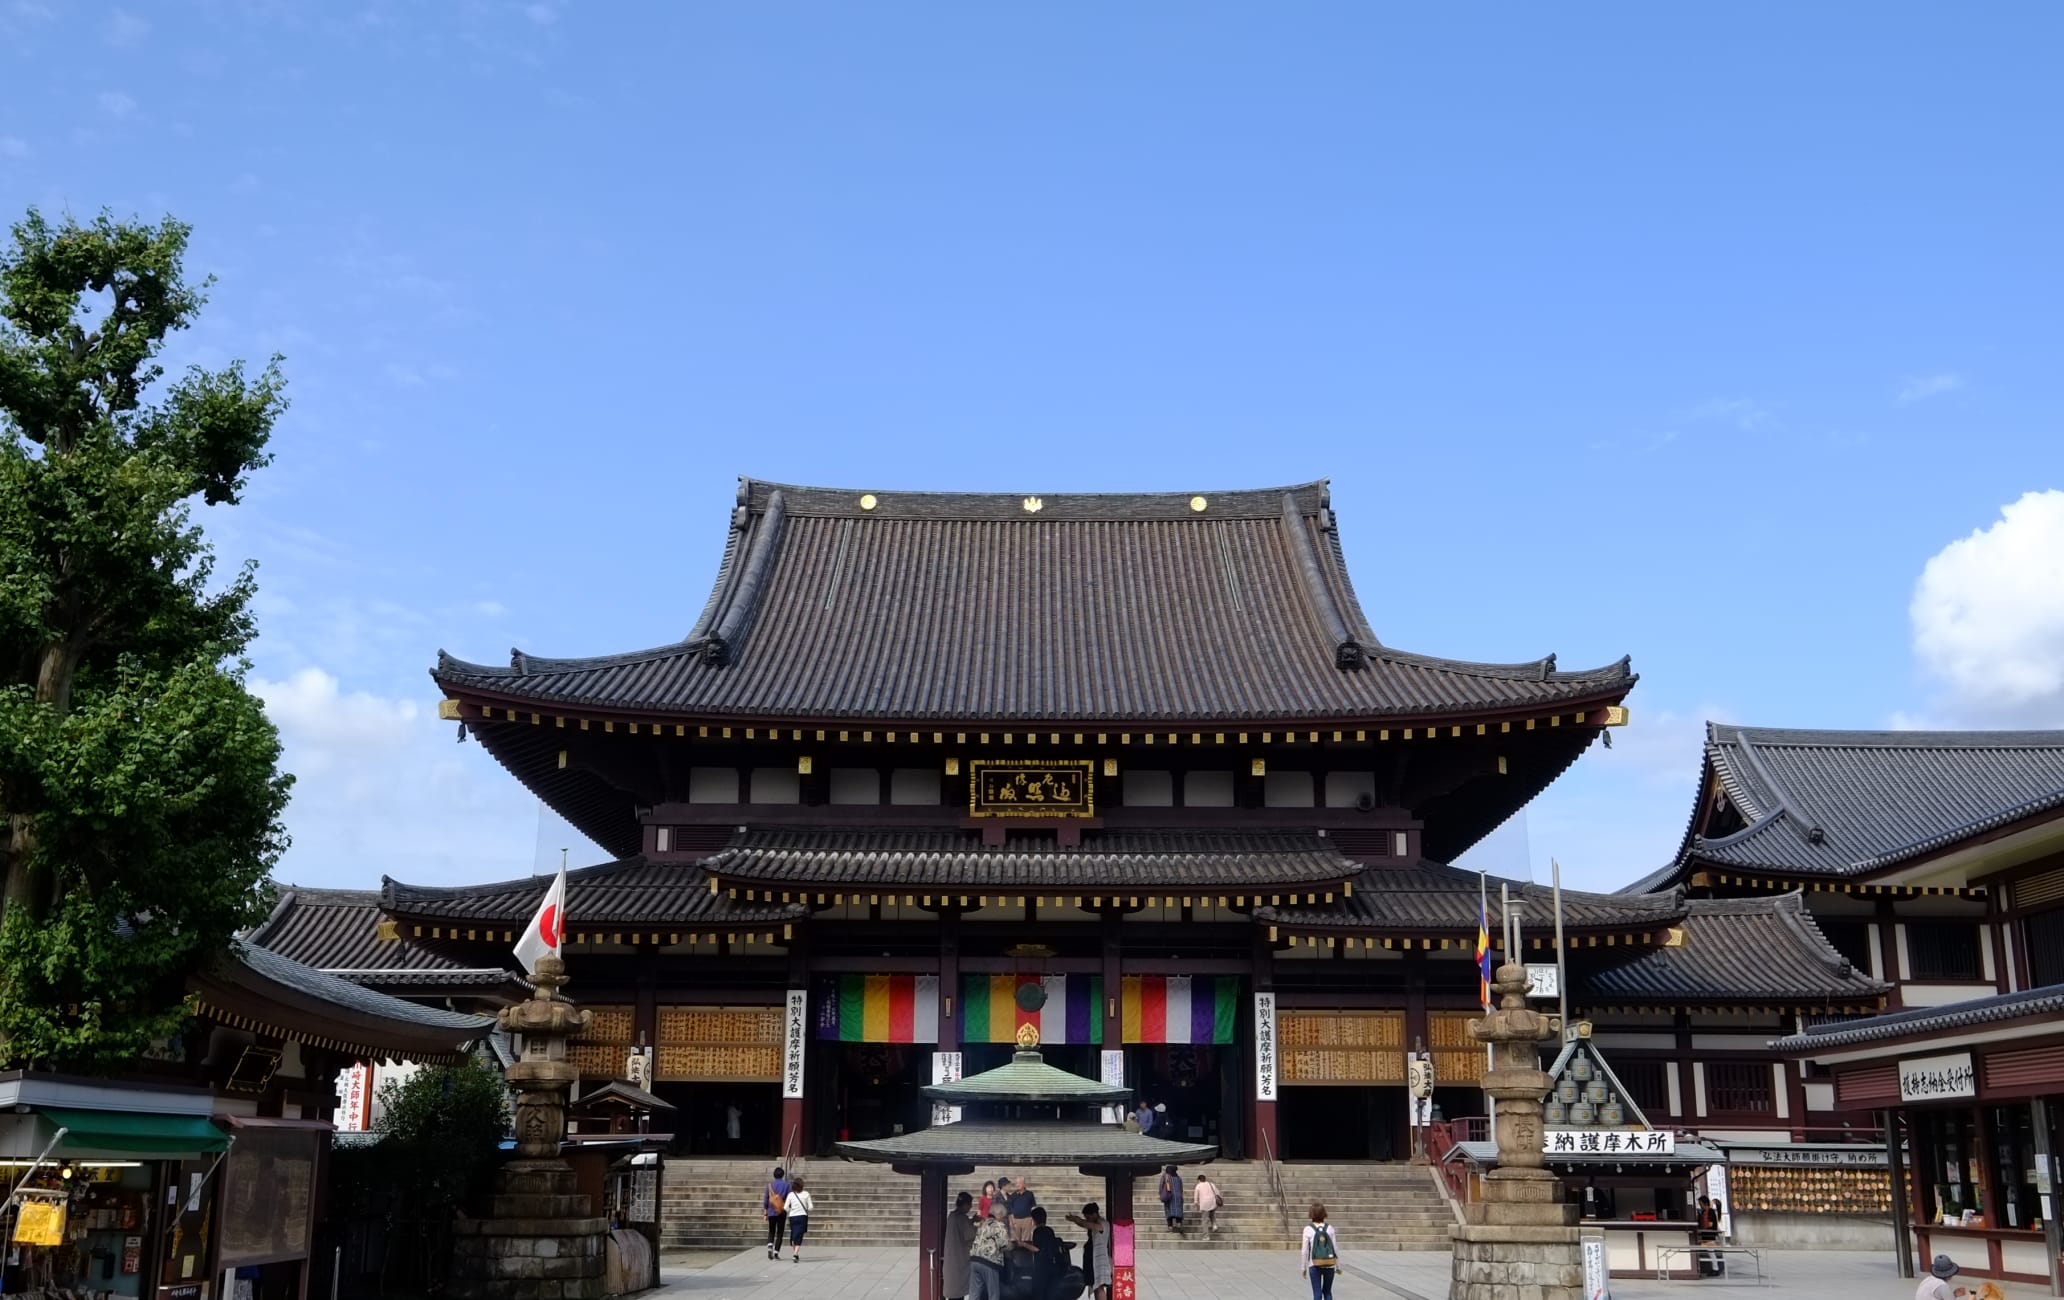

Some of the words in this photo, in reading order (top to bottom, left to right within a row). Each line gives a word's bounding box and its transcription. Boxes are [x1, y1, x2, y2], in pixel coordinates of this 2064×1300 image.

[788, 995, 802, 1093] 特別大護摩祈願芳名
[1259, 997, 1272, 1095] 特別大護摩祈願芳名
